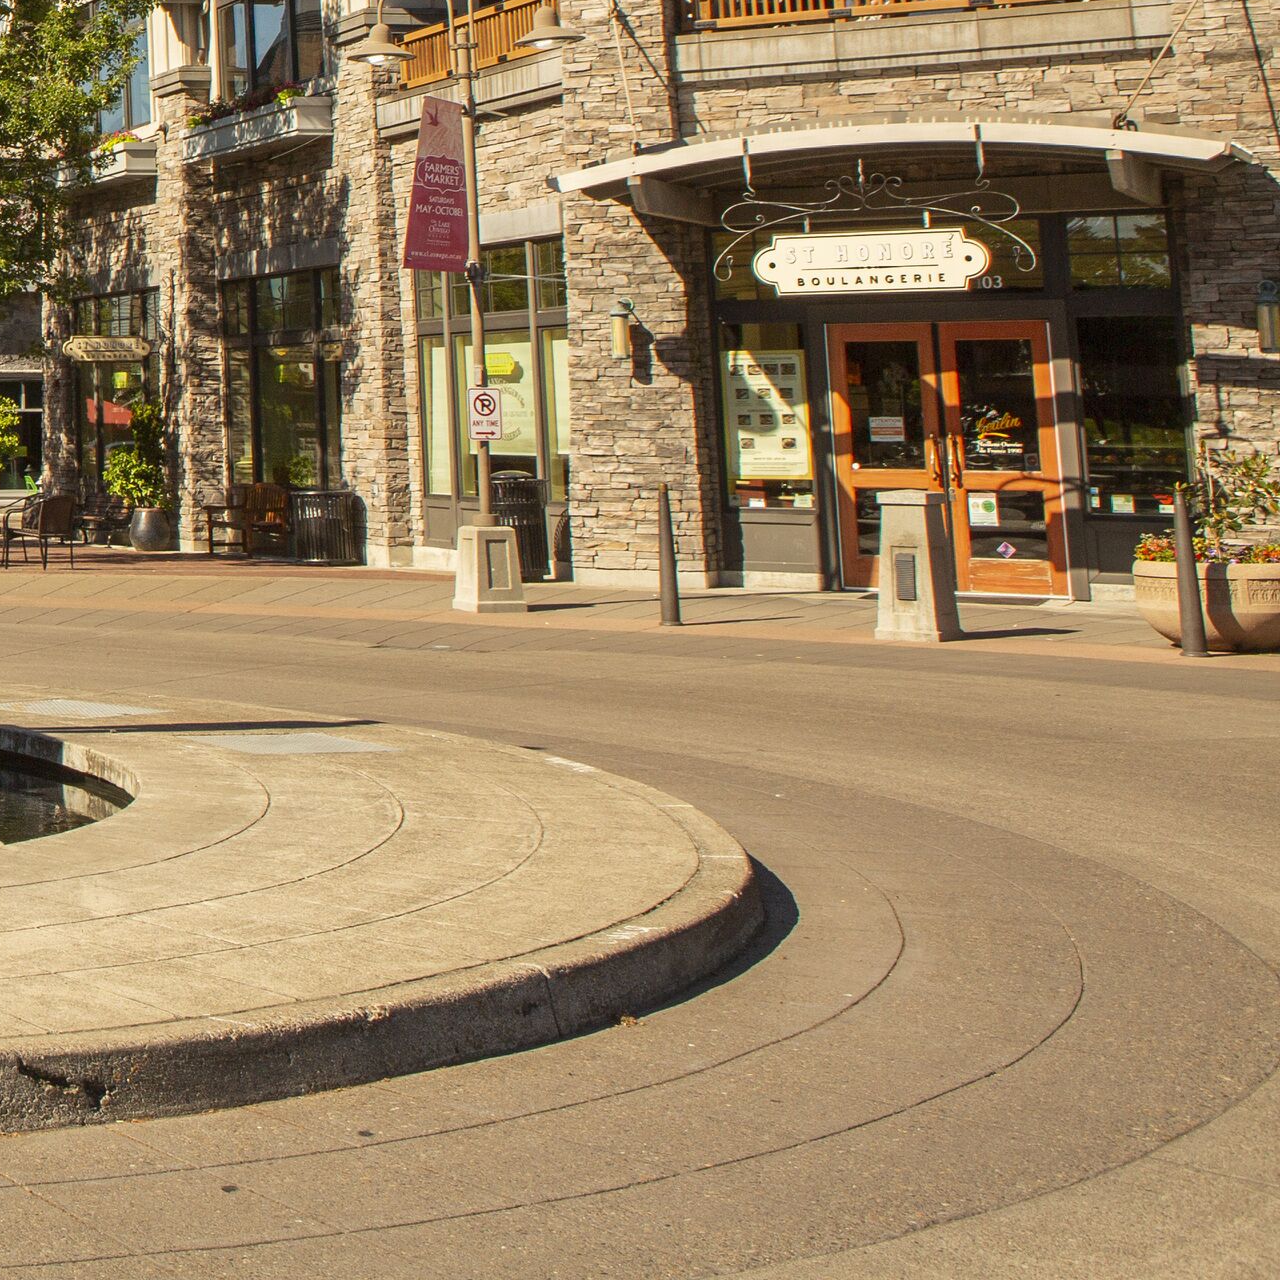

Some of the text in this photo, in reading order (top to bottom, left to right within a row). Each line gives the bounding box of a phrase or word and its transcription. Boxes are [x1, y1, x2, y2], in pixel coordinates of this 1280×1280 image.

[424, 173, 460, 187] MARKET
[784, 233, 955, 264] ST HONORÉ
[796, 273, 946, 287] BOULANGERIE
[472, 420, 500, 428] ANY TIME
